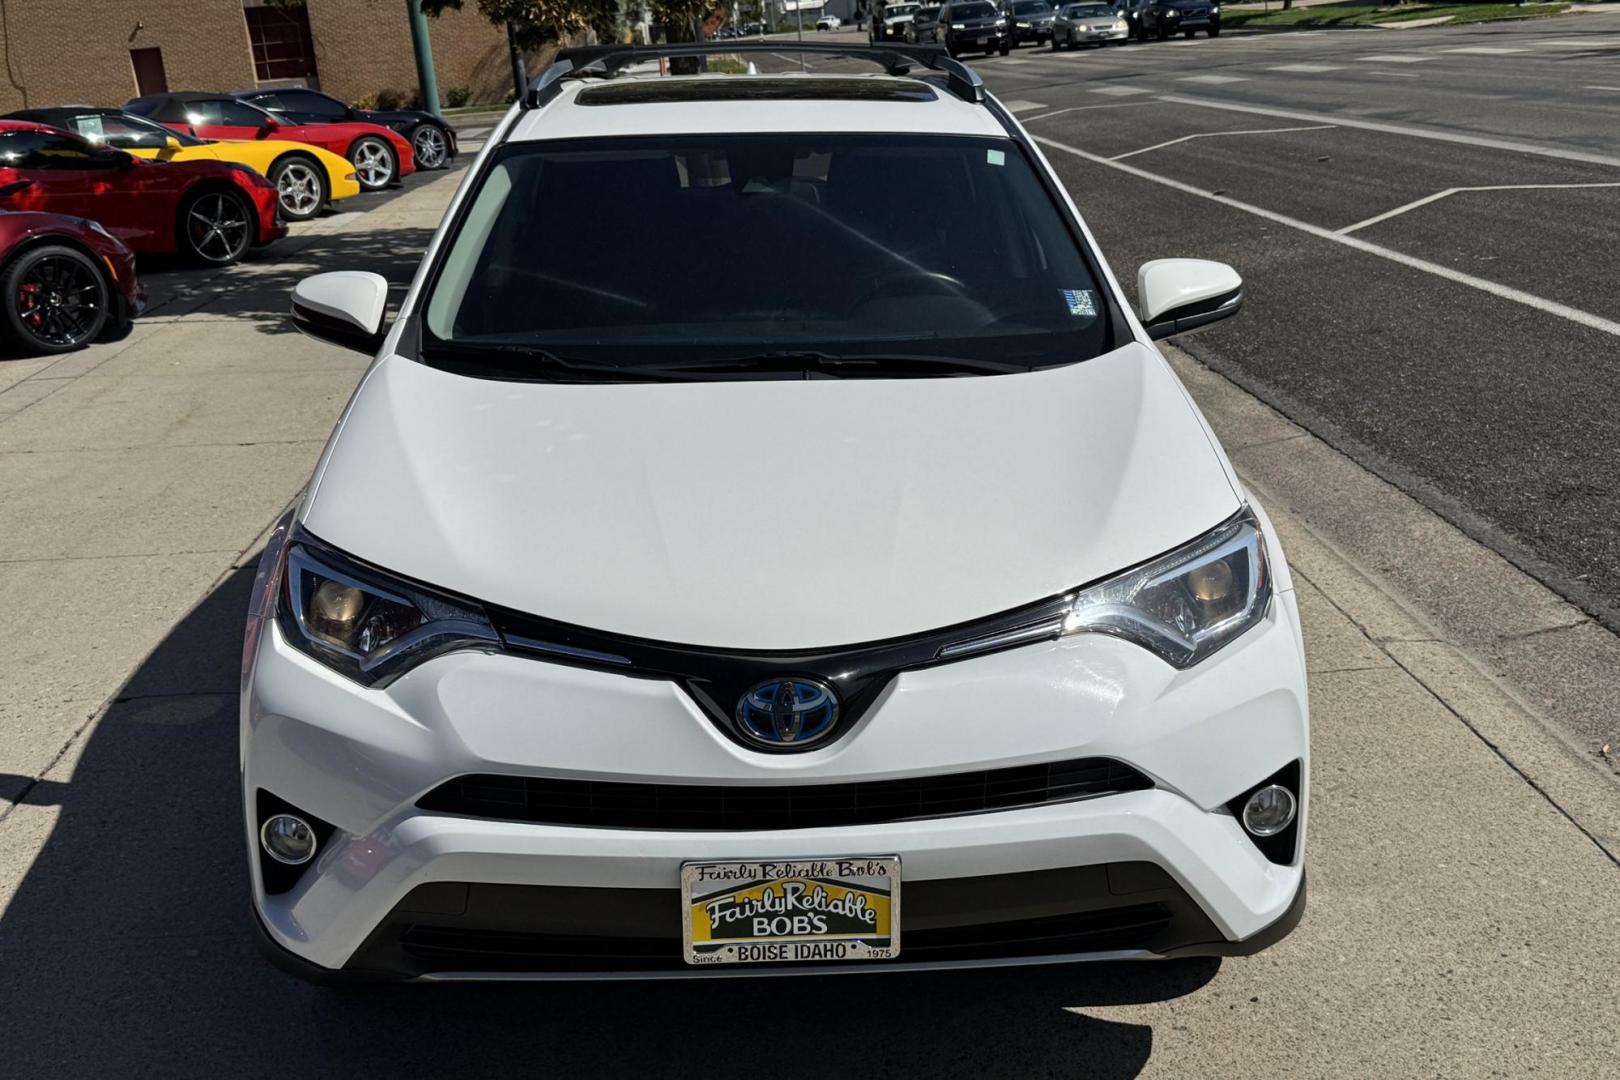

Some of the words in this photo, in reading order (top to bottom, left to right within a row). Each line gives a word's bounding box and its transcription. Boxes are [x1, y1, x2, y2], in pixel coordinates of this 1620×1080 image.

[696, 865, 757, 881] Fairly
[760, 863, 833, 879] Reliable
[836, 861, 887, 877] Bob's
[753, 912, 828, 936] BOB'S
[693, 954, 723, 964] Since
[738, 945, 788, 961] BOISE
[795, 943, 846, 959] IDAHO
[867, 949, 892, 958] 1975
